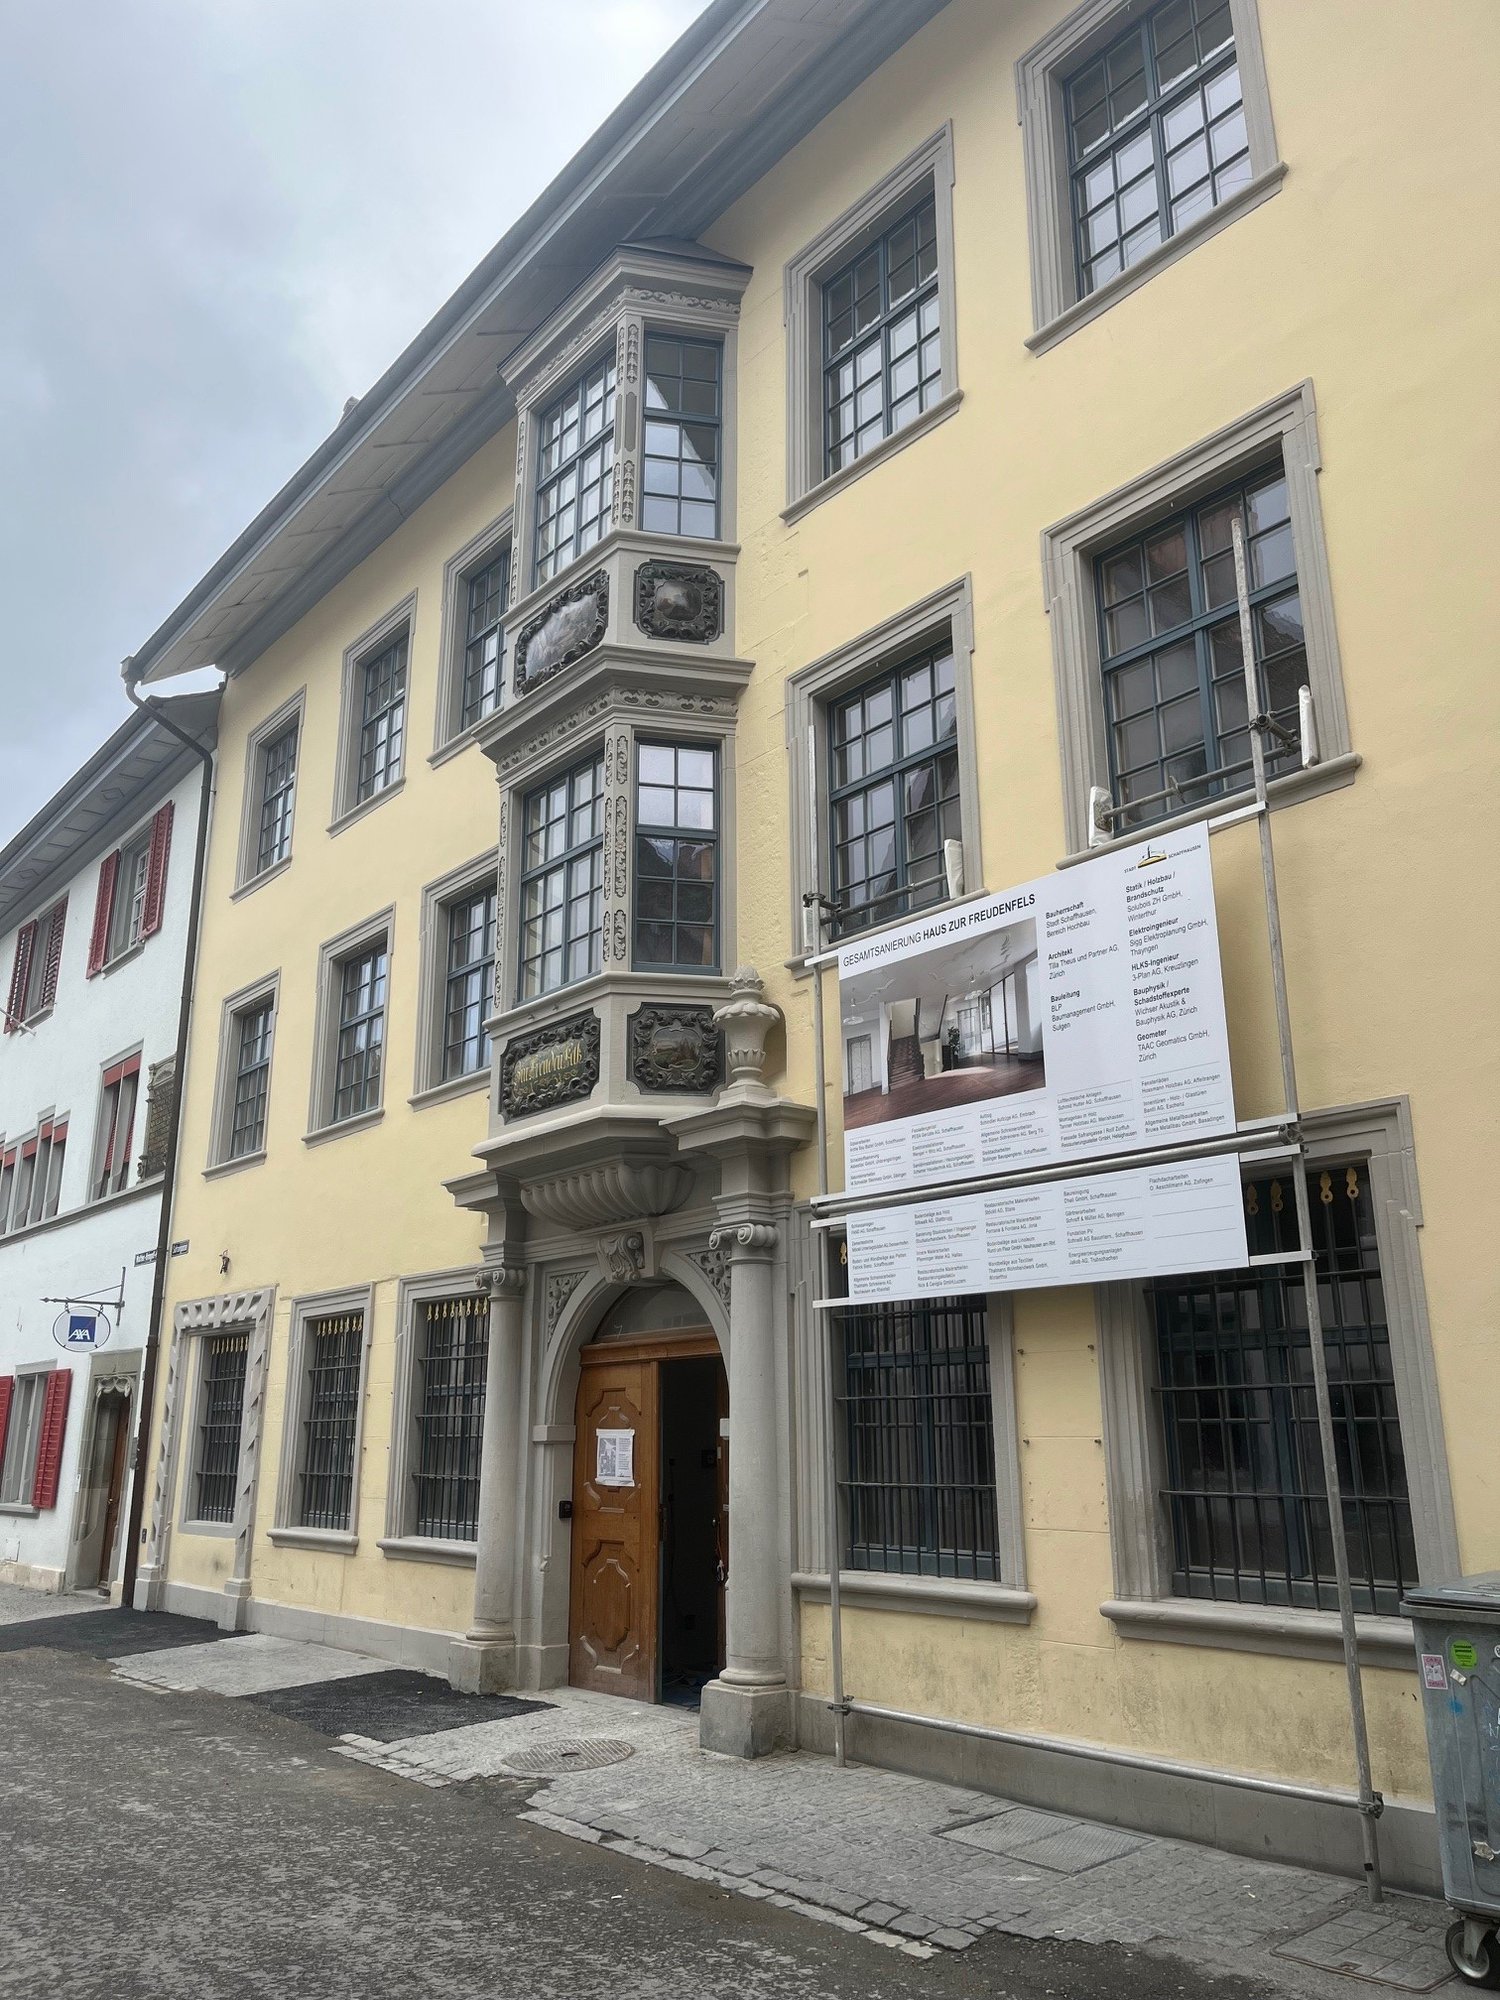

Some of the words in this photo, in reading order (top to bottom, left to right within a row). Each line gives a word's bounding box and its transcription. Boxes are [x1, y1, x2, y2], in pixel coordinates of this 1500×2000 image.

[1126, 882, 1143, 893] Statik
[1147, 874, 1172, 886] Holzbau
[1126, 886, 1165, 903] Brandschutz
[1045, 901, 1084, 919] Bauherrschaft
[1128, 909, 1157, 923] Winterthur
[843, 931, 921, 967] GESAMTSANIERUNG
[923, 923, 947, 941] HAUS
[948, 916, 967, 932] ZUR
[968, 893, 1036, 926] FREUDENFELS
[1046, 918, 1059, 929] Stadt
[1047, 926, 1066, 938] Bereich
[1067, 920, 1090, 932] Hochbau
[1129, 918, 1179, 937] Elektroingenieur
[1130, 938, 1143, 947] Sigg
[1143, 926, 1186, 943] Elektroplanung
[1048, 947, 1073, 961] Architekt
[1060, 957, 1076, 967] Theus
[1077, 952, 1087, 962] und
[1088, 948, 1108, 959] Partner
[1108, 944, 1120, 953] AG,
[1130, 944, 1159, 957] Thayngen
[1131, 953, 1180, 971] HLKS-Ingenieur
[1132, 972, 1151, 981] 3-Plan
[1164, 959, 1199, 973] Kreuzlingen
[1049, 969, 1065, 980] Zürich
[1050, 990, 1080, 1003] Bauleitung
[1133, 981, 1166, 996] Bauphysik
[1134, 986, 1191, 1006] Schadstoffexperte
[1051, 1003, 1063, 1012] BLP
[1052, 1004, 1096, 1022] Baumanagement
[1135, 1006, 1158, 1016] Wichser
[1159, 999, 1180, 1011] Akustik
[1136, 1013, 1165, 1027] Bauphysik
[1179, 1005, 1198, 1017] Zürich
[1052, 1022, 1071, 1032] Sulgen
[1137, 1029, 1167, 1042] Geometer
[1138, 1041, 1155, 1052] TAAC
[1156, 1036, 1187, 1048] Geomatics
[1138, 1051, 1157, 1062] Zürich
[68, 1329, 90, 1340] AXA
